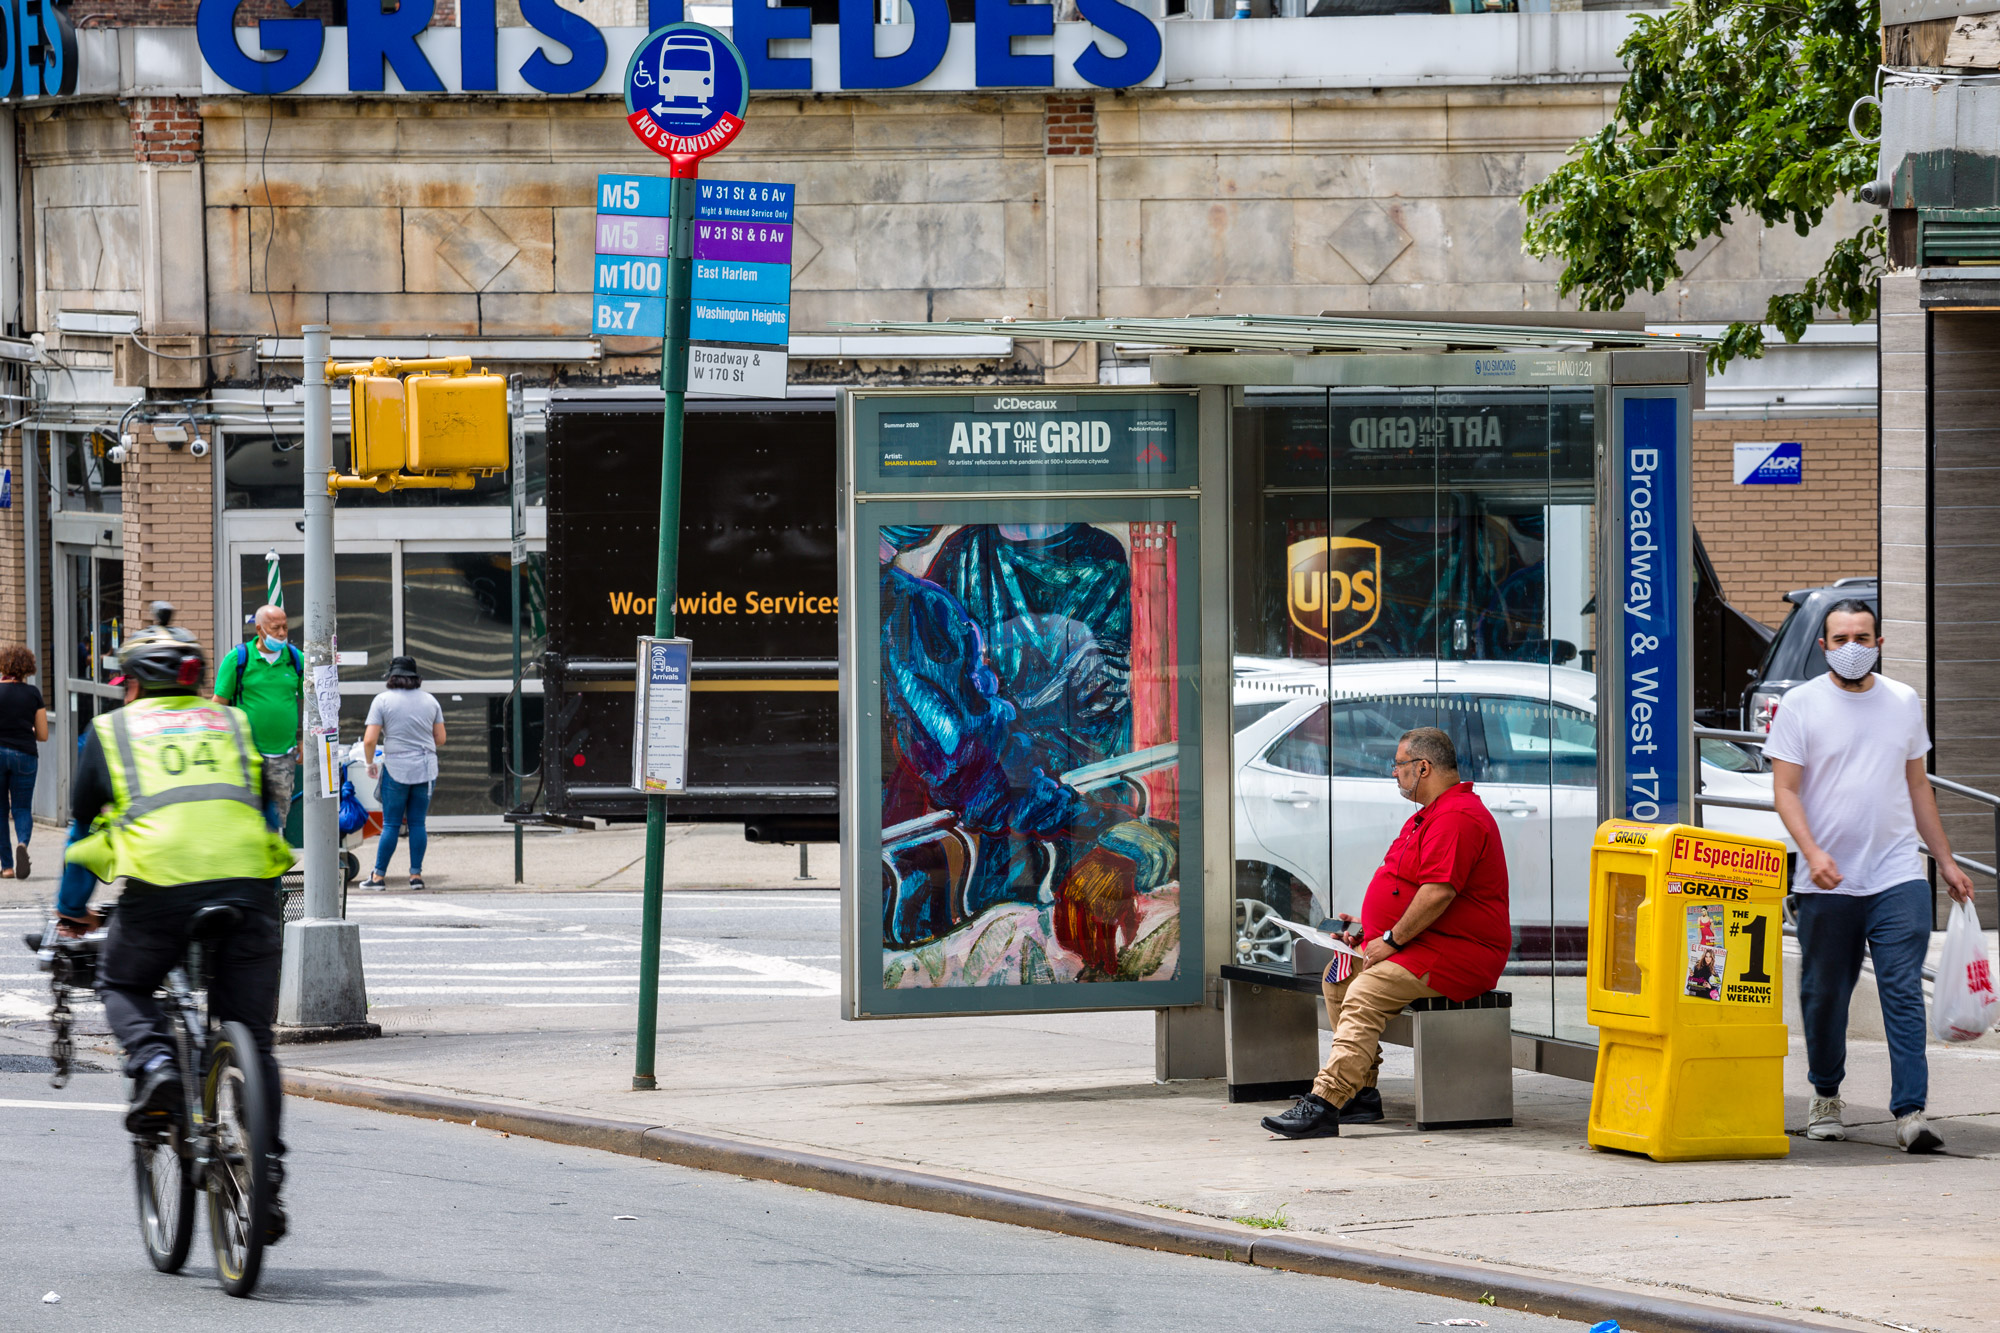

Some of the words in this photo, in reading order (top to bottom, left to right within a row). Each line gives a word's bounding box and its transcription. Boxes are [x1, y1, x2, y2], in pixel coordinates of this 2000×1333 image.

[636, 114, 658, 138] NO
[658, 118, 734, 152] STANDING
[602, 181, 640, 210] M5
[701, 185, 712, 199] W
[716, 186, 728, 200] 31
[733, 187, 744, 200] St
[749, 188, 757, 200] &
[761, 188, 768, 201] 6
[772, 189, 786, 202] Av
[700, 206, 716, 216] Night
[724, 208, 750, 217] Weekend
[751, 208, 773, 218] Service
[774, 210, 788, 220] Only
[601, 222, 638, 249] M5
[656, 234, 665, 251] LTD
[700, 226, 711, 239] W
[714, 226, 727, 240] 31
[731, 227, 742, 241] St
[747, 228, 755, 241] &
[759, 229, 767, 242] 6
[770, 229, 784, 242] Av
[600, 261, 661, 290] M100
[697, 265, 718, 279] East
[722, 266, 758, 281] Harlem
[598, 302, 641, 330] Bx7
[696, 306, 749, 322] Washington
[752, 309, 786, 325] Heights
[694, 350, 748, 366] Broadway
[753, 354, 761, 366] &
[1483, 360, 1491, 371] NO
[1492, 360, 1516, 371] SMOKING
[694, 367, 705, 379] W
[709, 368, 728, 381] 170
[732, 369, 744, 382] St
[1557, 360, 1592, 377] MN01221
[994, 397, 1057, 410] JCDecaux
[949, 422, 1010, 454] ART
[1014, 422, 1036, 439] ON
[1040, 421, 1111, 454] GRID
[1013, 440, 1037, 453] THE
[1760, 456, 1800, 470] ADR
[1624, 448, 1658, 622] Broadway
[1294, 570, 1375, 628] ups
[1631, 636, 1659, 658] &
[1631, 666, 1658, 755] West
[162, 742, 218, 776] 04
[1615, 831, 1648, 845] GRATIS
[1674, 838, 1690, 860] El
[1694, 841, 1780, 873] Especialito
[1668, 884, 1682, 893] UNO
[1683, 882, 1749, 900] GRATIS
[1732, 910, 1749, 918] THE
[1727, 985, 1771, 995] HISPANIC
[1727, 993, 1771, 1004] WEEKLY!
